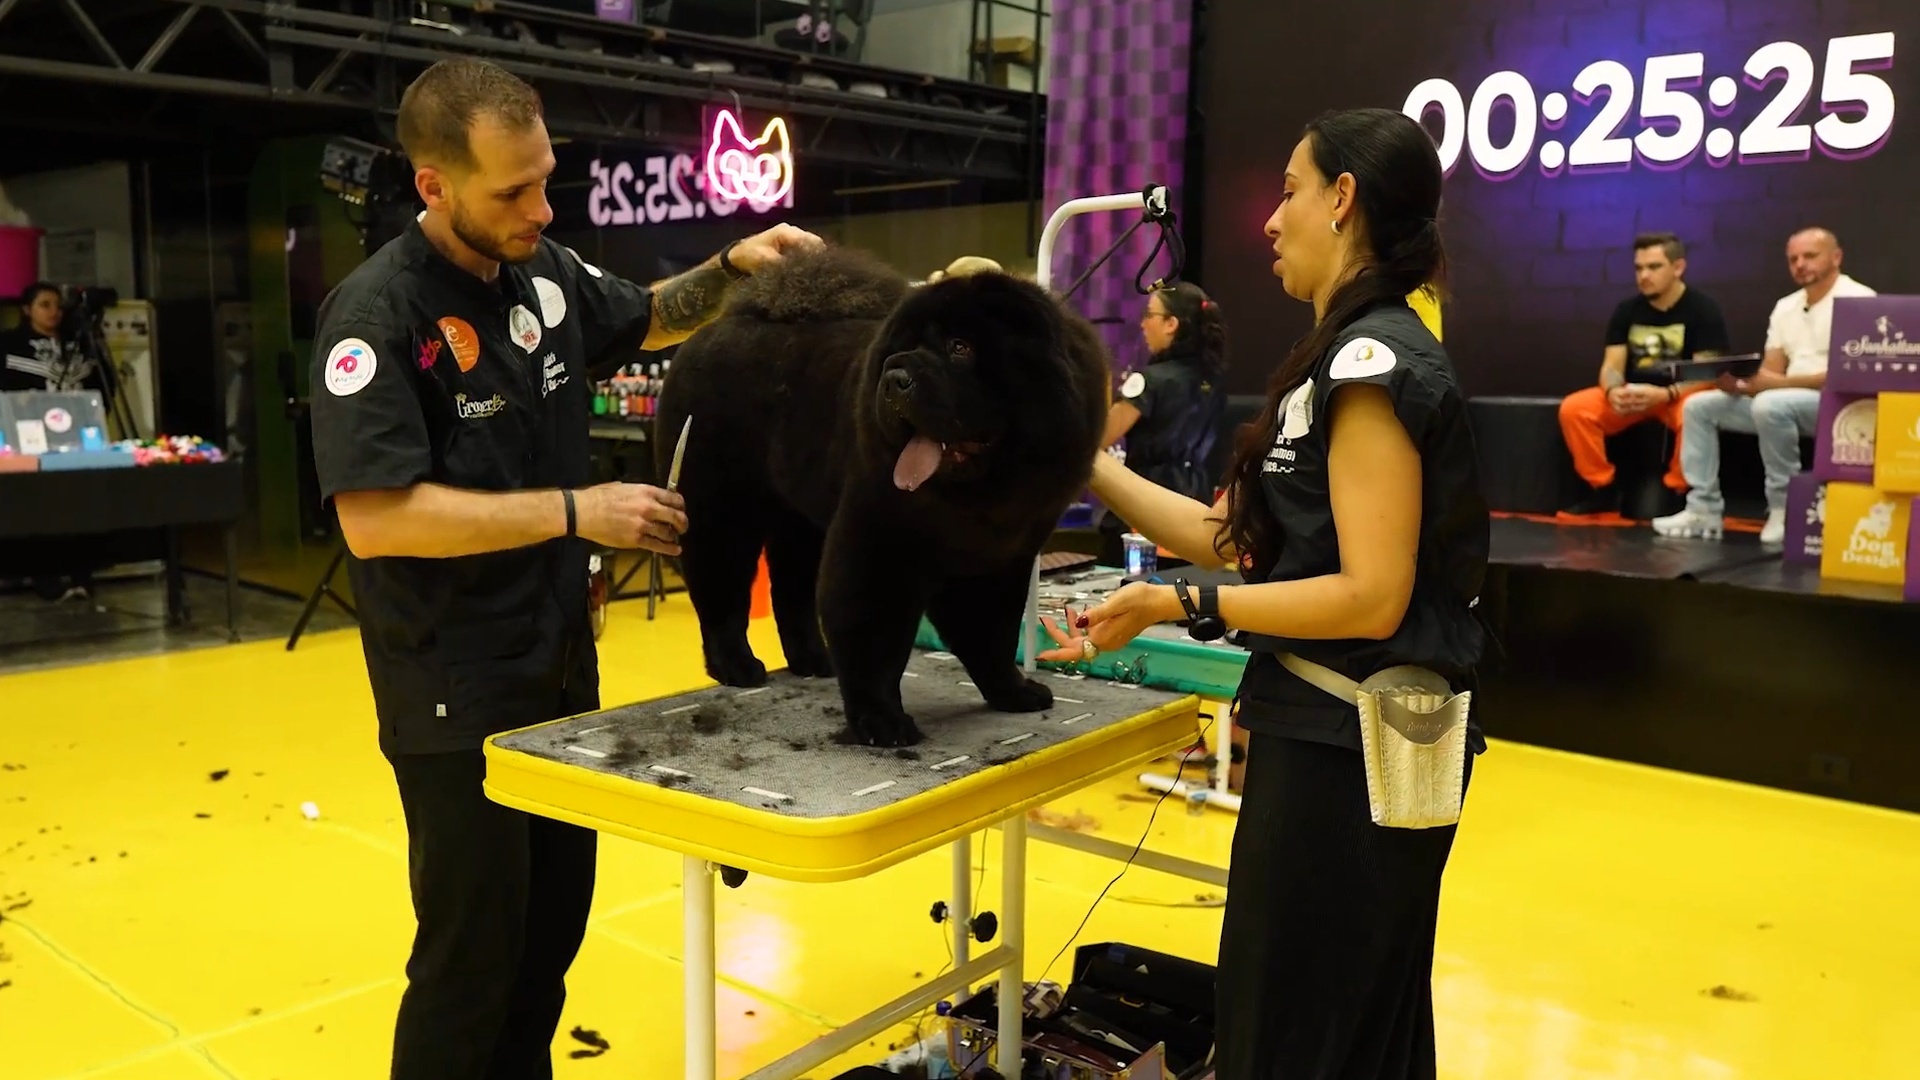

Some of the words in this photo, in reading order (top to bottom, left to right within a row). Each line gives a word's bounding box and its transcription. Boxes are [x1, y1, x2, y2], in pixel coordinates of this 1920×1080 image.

[1402, 32, 1895, 173] 00:25:25
[1850, 534, 1896, 558] Dog
[1842, 549, 1900, 569] Design
